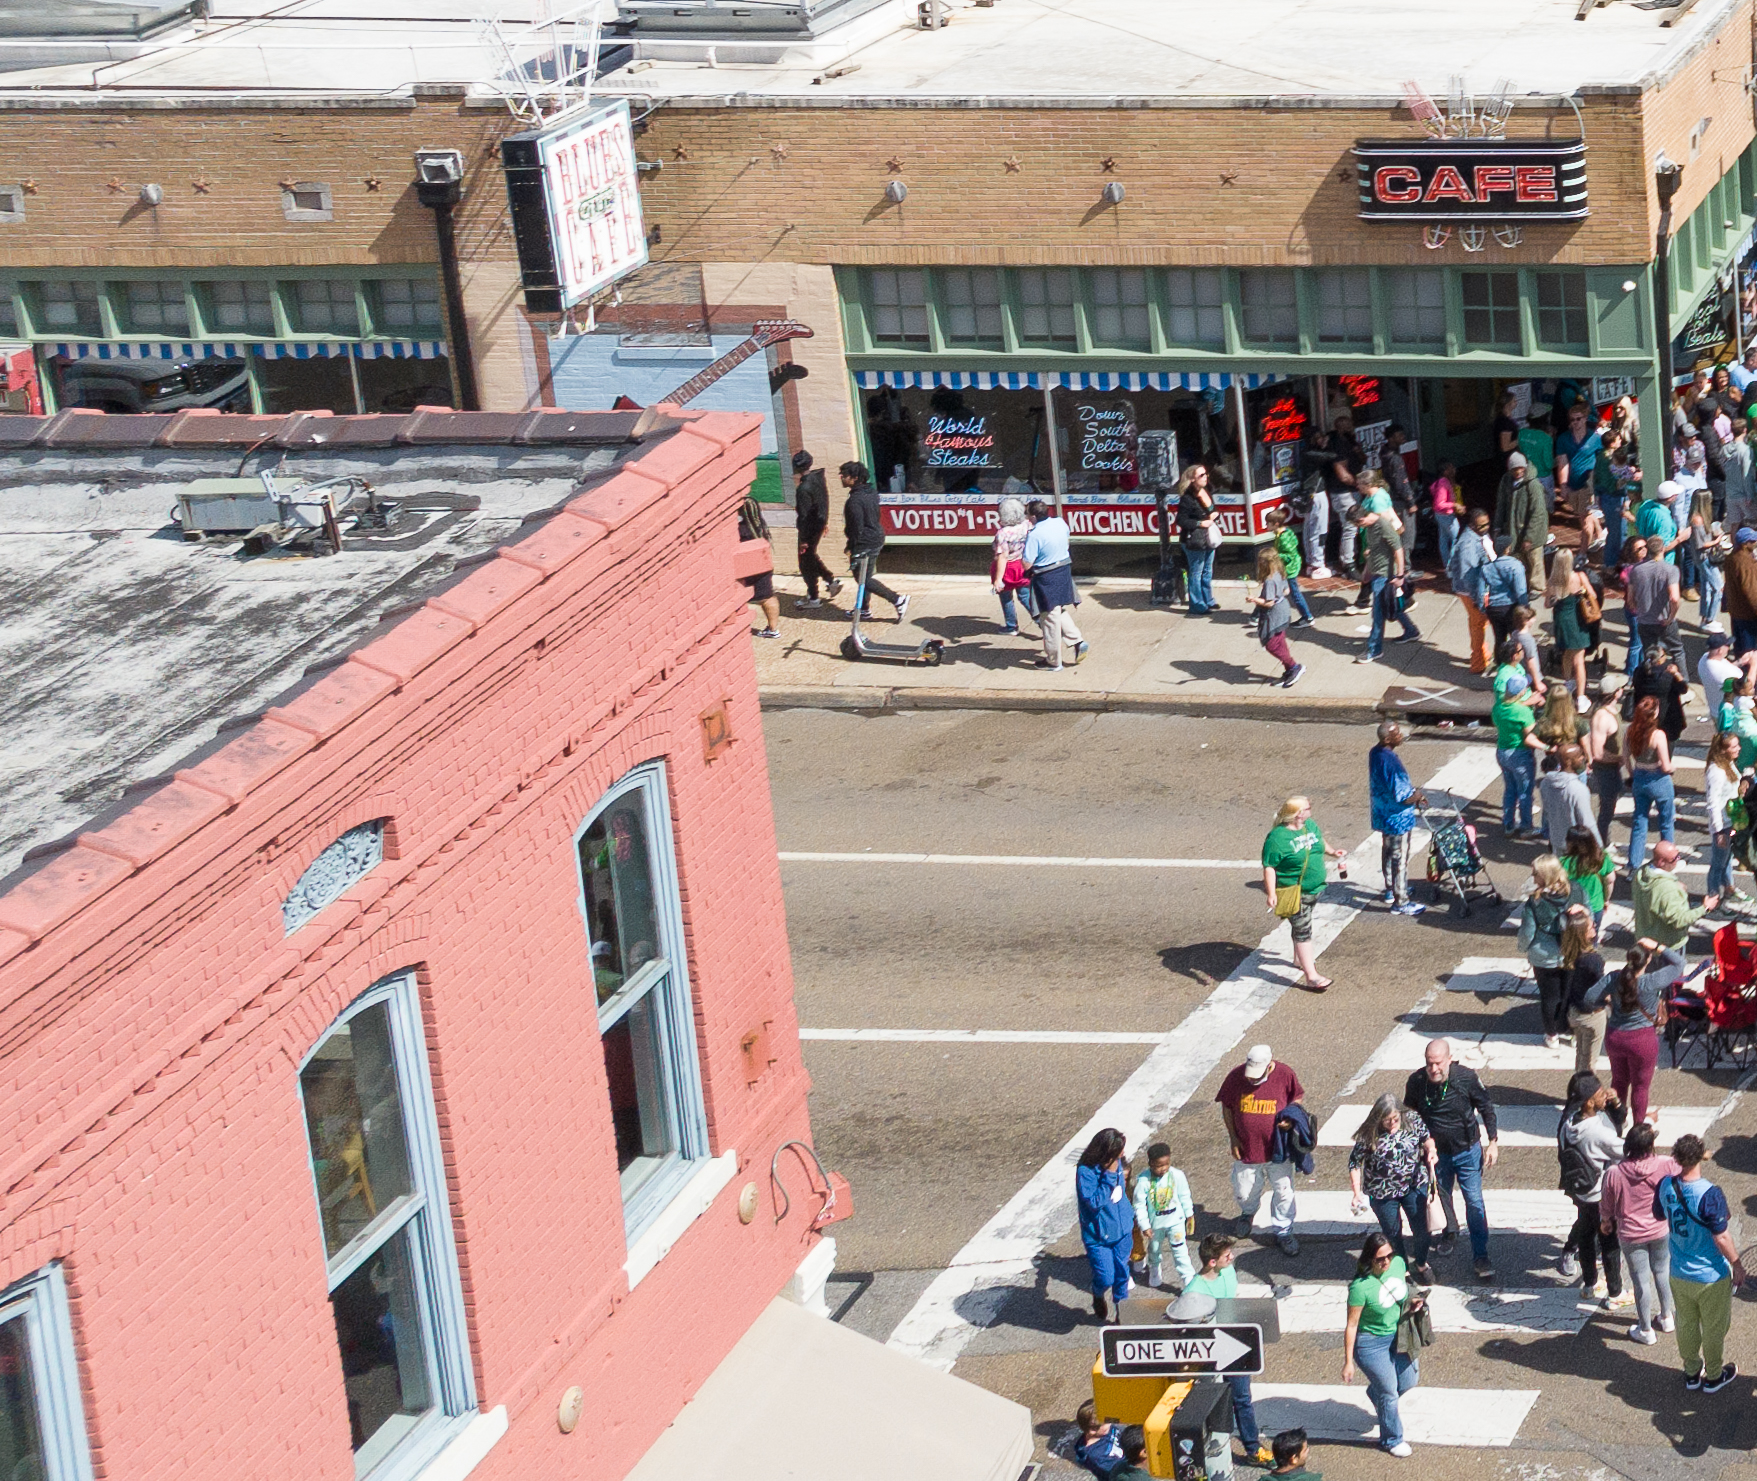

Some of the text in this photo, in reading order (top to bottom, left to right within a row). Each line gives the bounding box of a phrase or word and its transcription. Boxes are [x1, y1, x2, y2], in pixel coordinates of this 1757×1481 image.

[556, 122, 626, 206] BLUES
[1373, 165, 1558, 204] CAFE
[566, 181, 637, 284] CAFE
[928, 416, 987, 435] World
[1085, 422, 1131, 437] South
[924, 433, 995, 449] Famous
[1081, 438, 1127, 454] Delta
[928, 449, 991, 467] Steaks
[890, 510, 958, 530] VOTED
[1067, 512, 1247, 533] KITCHEN ATE
[1123, 1340, 1216, 1361] ONE WAY
